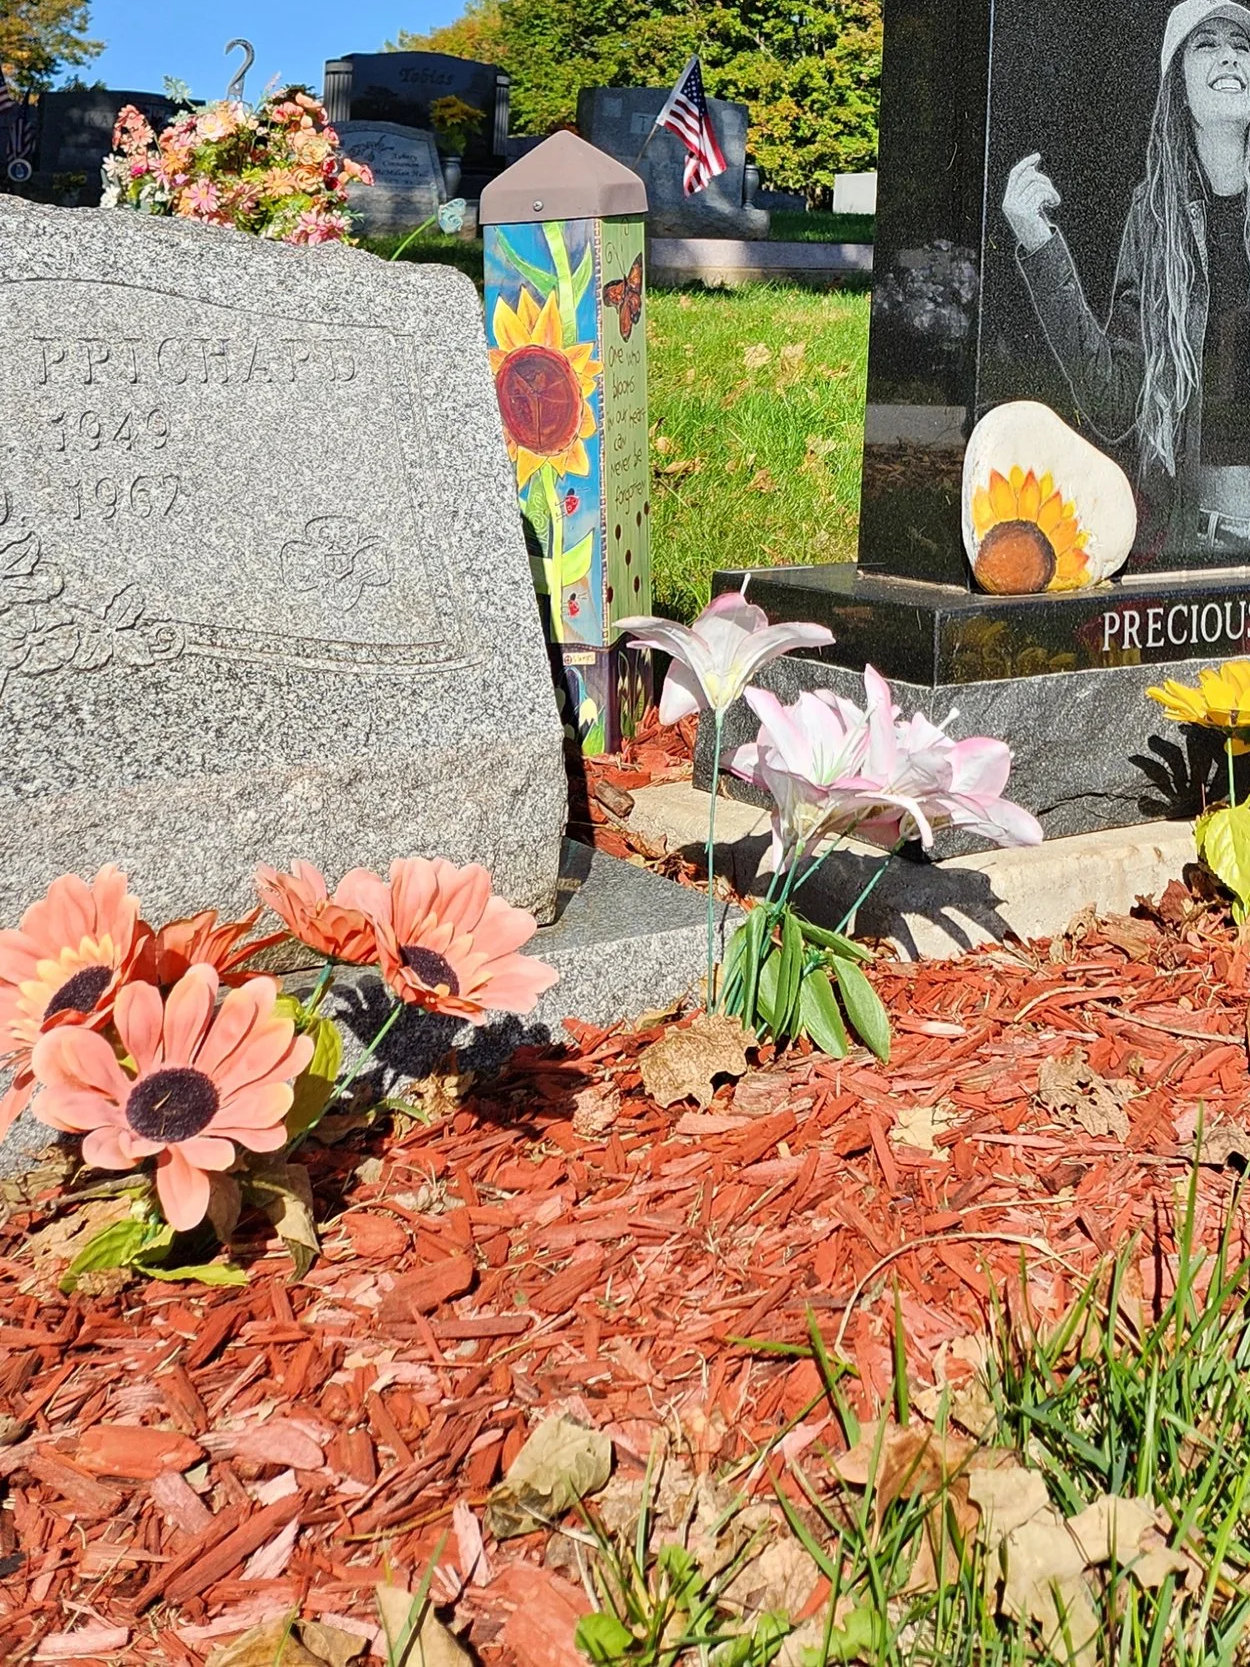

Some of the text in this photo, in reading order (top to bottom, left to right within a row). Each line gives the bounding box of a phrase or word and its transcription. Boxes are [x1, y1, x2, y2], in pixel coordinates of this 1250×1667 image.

[399, 67, 454, 86] Tobias
[51, 408, 171, 452] 1949
[68, 474, 181, 521] 1967
